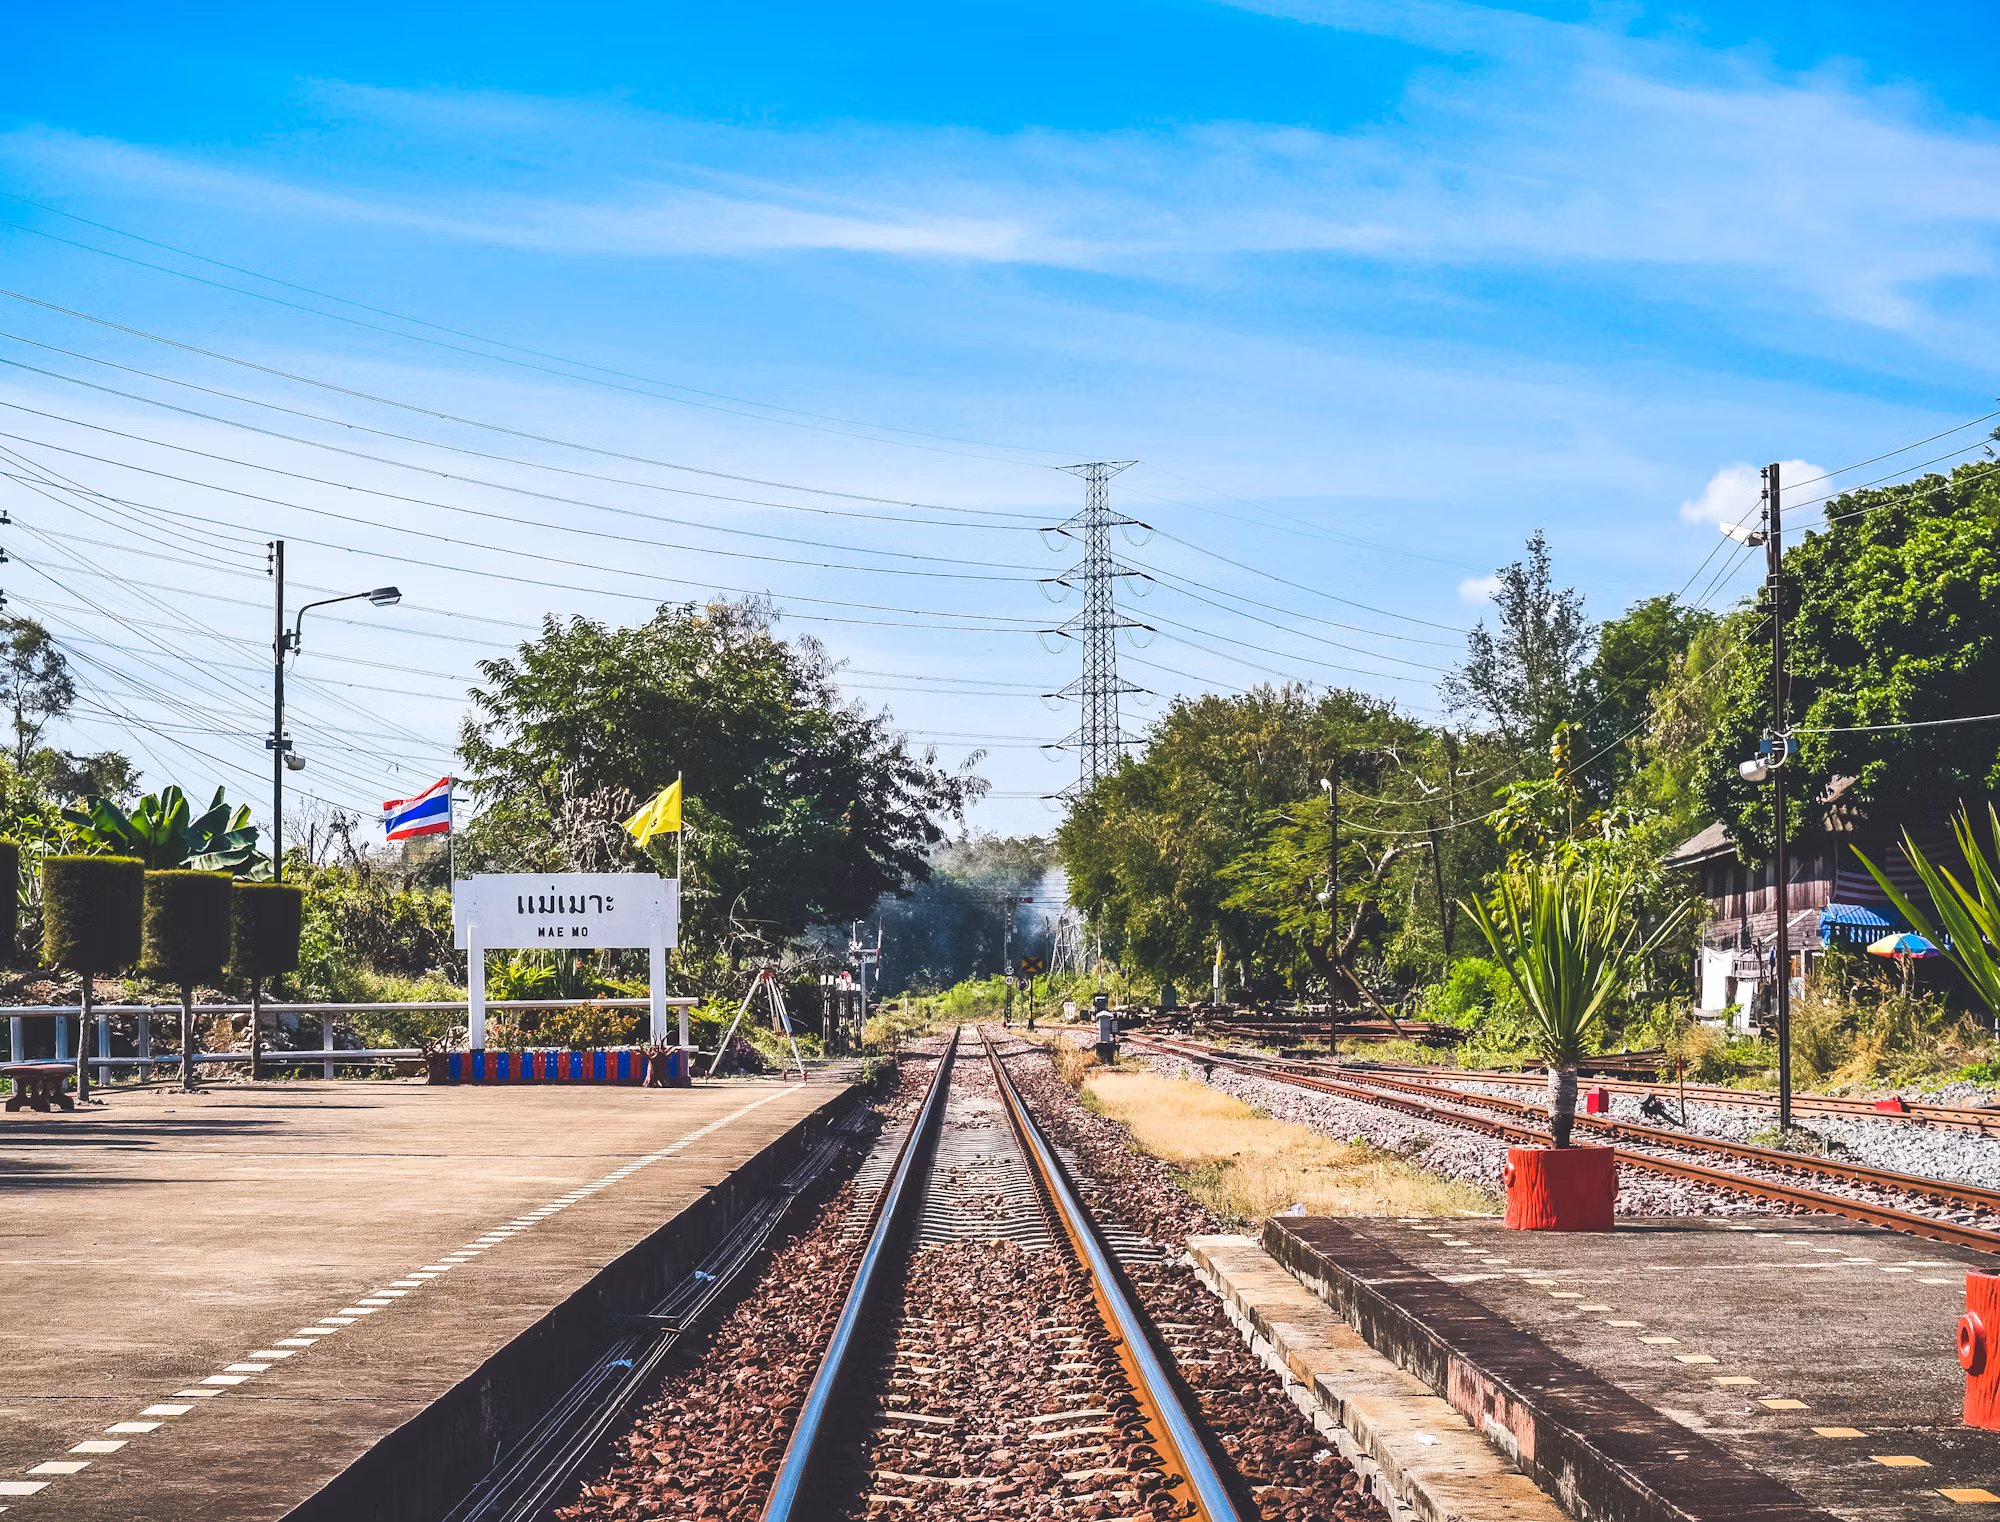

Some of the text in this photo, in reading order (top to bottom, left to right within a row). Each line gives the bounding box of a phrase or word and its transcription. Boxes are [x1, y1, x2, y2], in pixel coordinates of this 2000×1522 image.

[517, 885, 615, 915] แม่เมาะ
[537, 926, 588, 938] MAE MO
